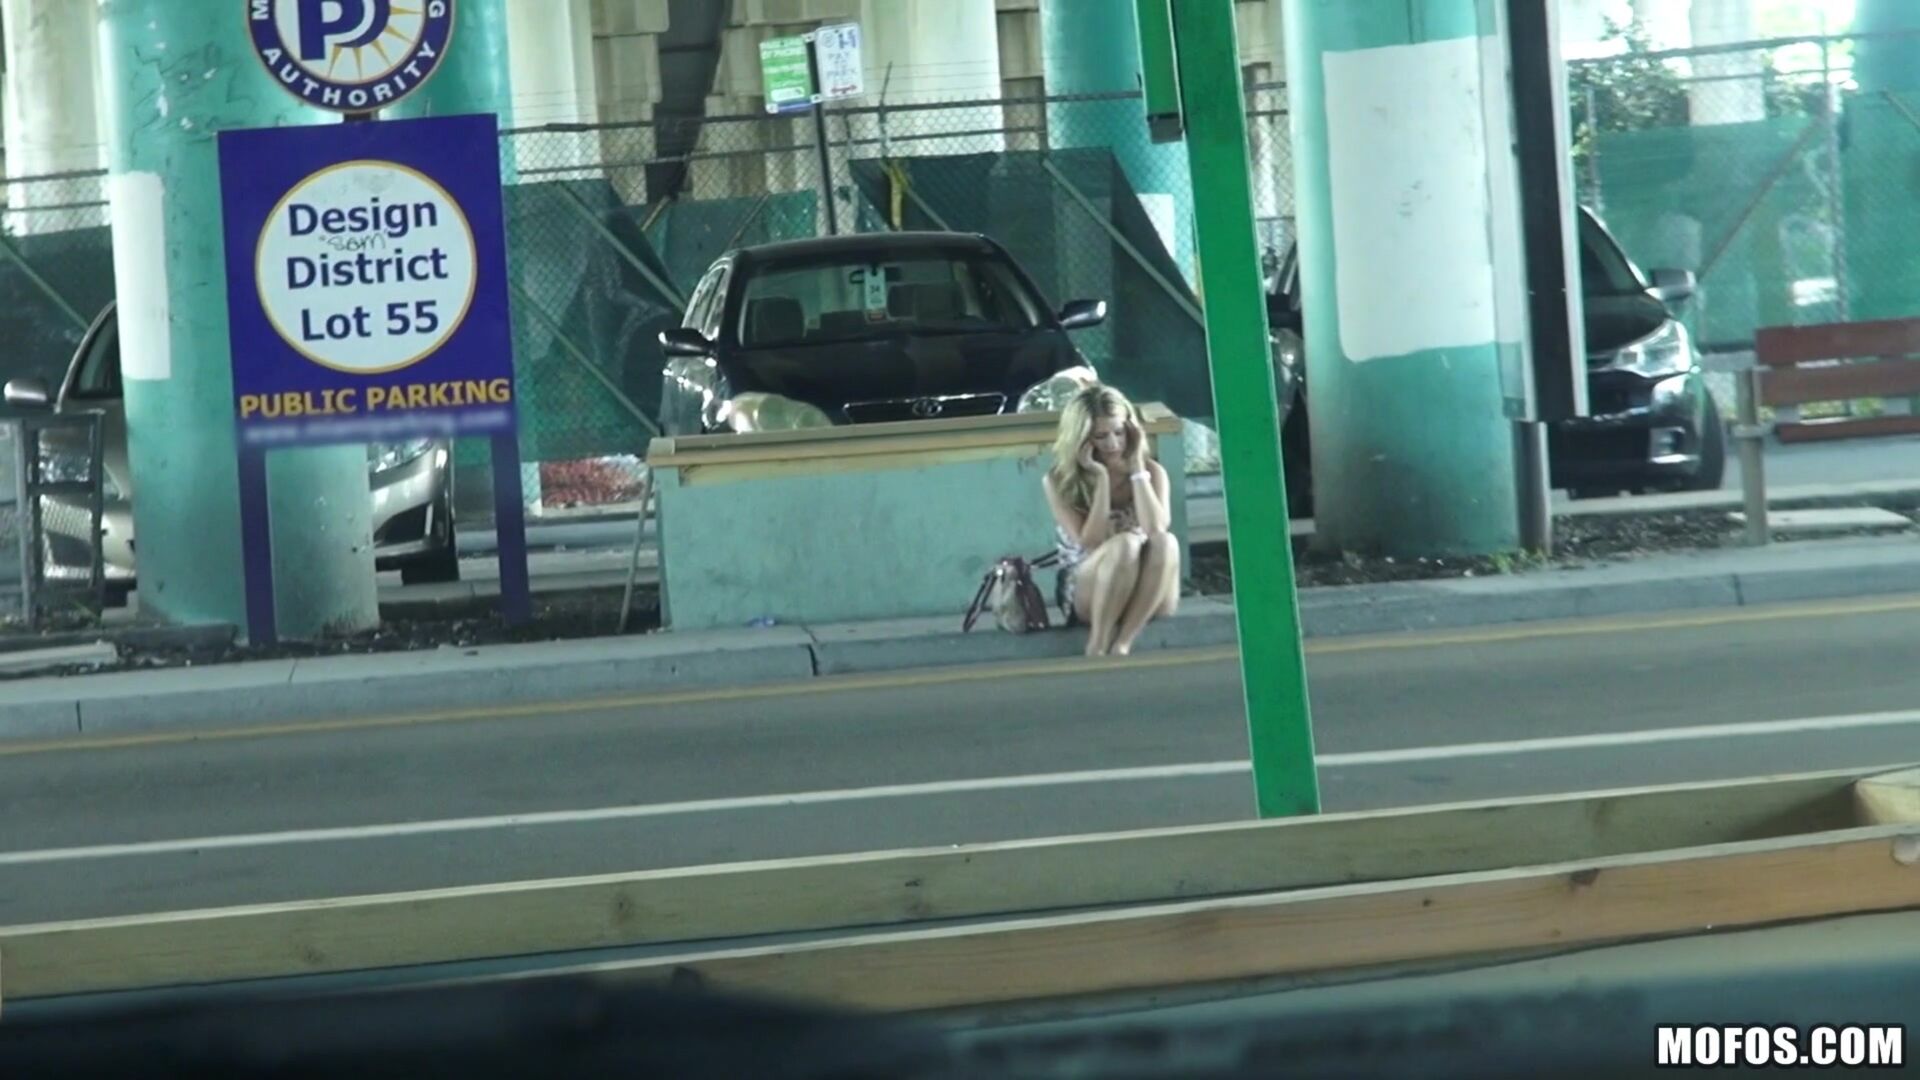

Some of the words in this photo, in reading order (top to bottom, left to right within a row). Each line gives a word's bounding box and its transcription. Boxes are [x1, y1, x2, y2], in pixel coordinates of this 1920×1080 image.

[262, 41, 436, 106] AUTHORITY
[288, 197, 438, 238] Design
[287, 248, 449, 290] District
[302, 306, 372, 342] Lot
[387, 300, 440, 336] 55
[240, 388, 357, 419] PUBLIC
[366, 378, 511, 411] PARKING
